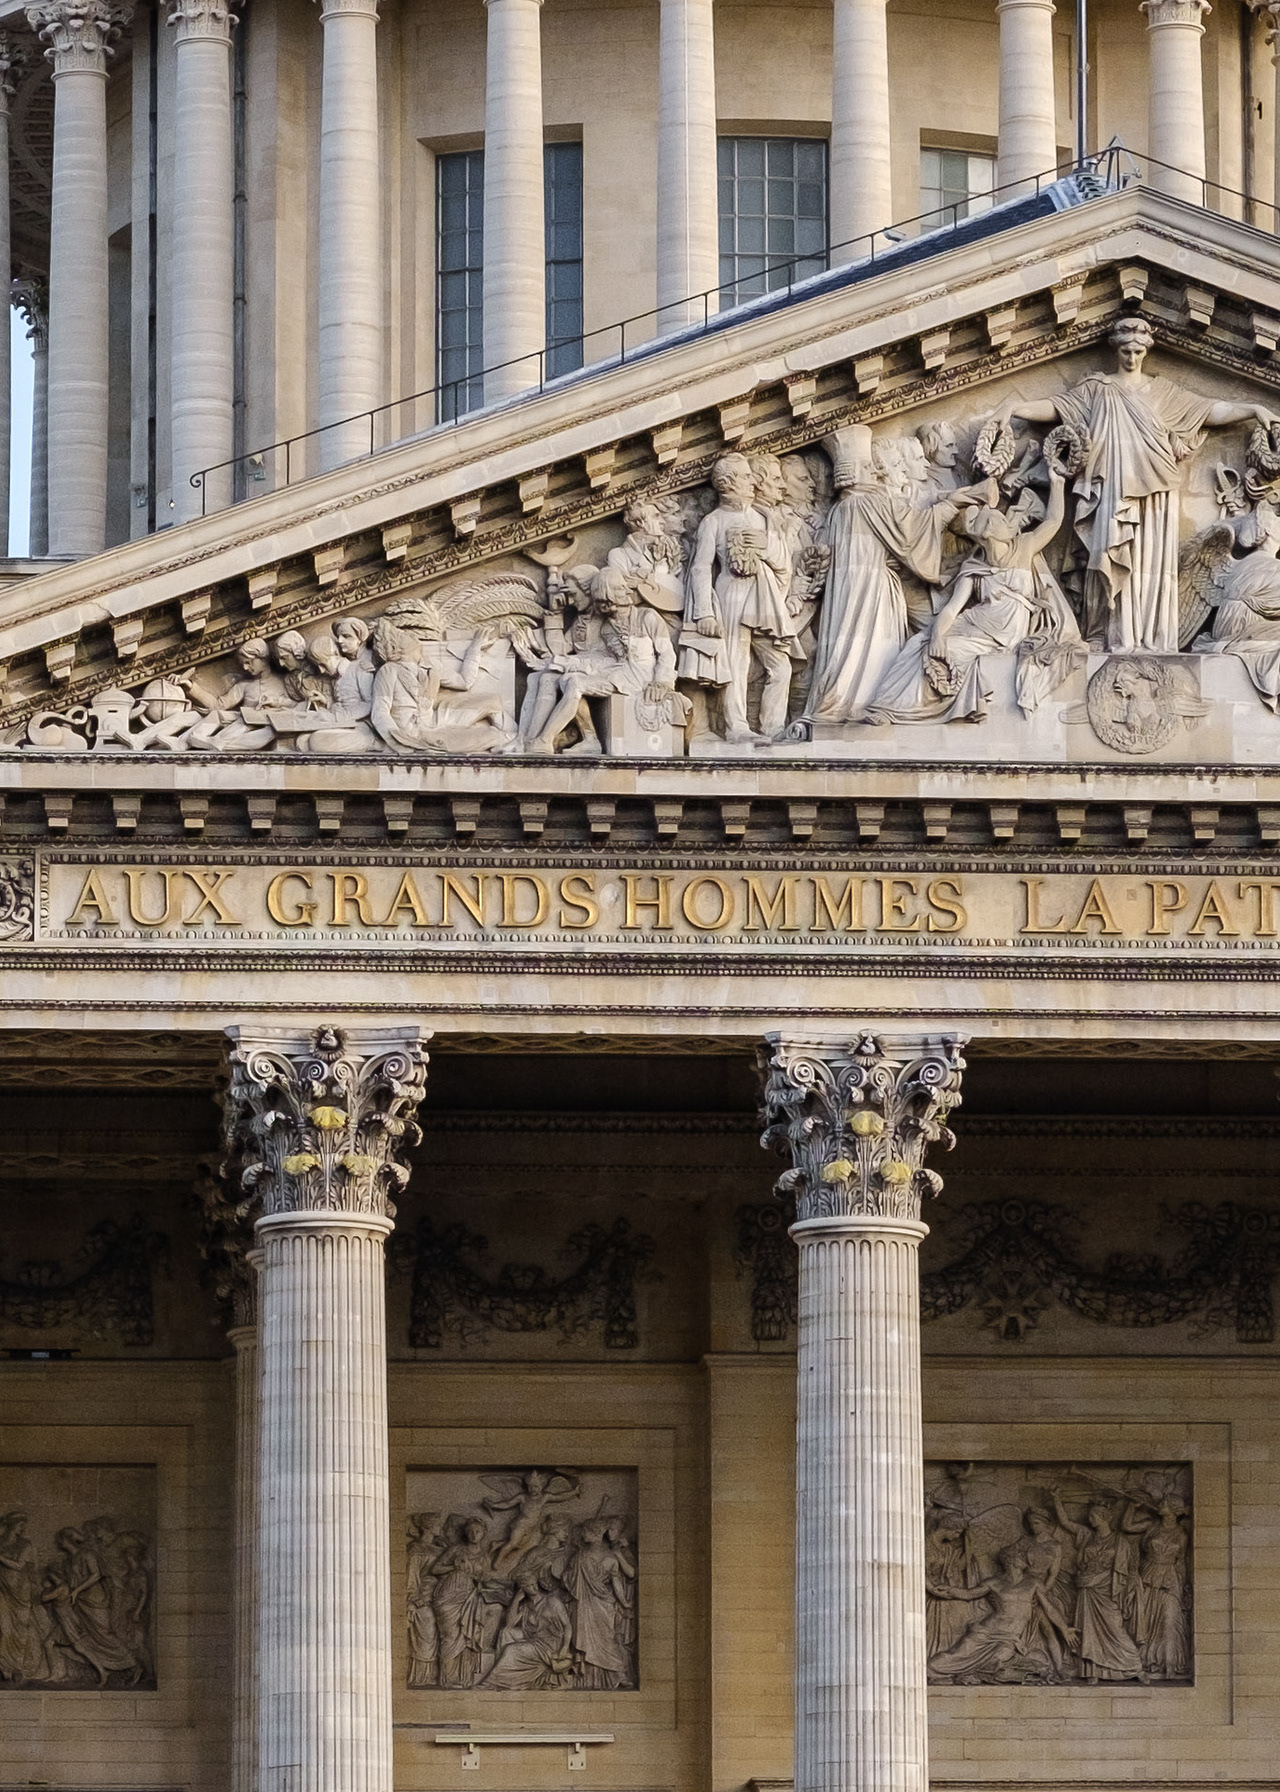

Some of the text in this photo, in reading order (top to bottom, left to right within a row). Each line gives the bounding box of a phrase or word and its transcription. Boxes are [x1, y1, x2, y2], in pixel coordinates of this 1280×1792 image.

[65, 868, 242, 926] AUX
[266, 869, 599, 929] GRANDS
[619, 874, 968, 934] HOMMES
[1021, 877, 1123, 935] LA
